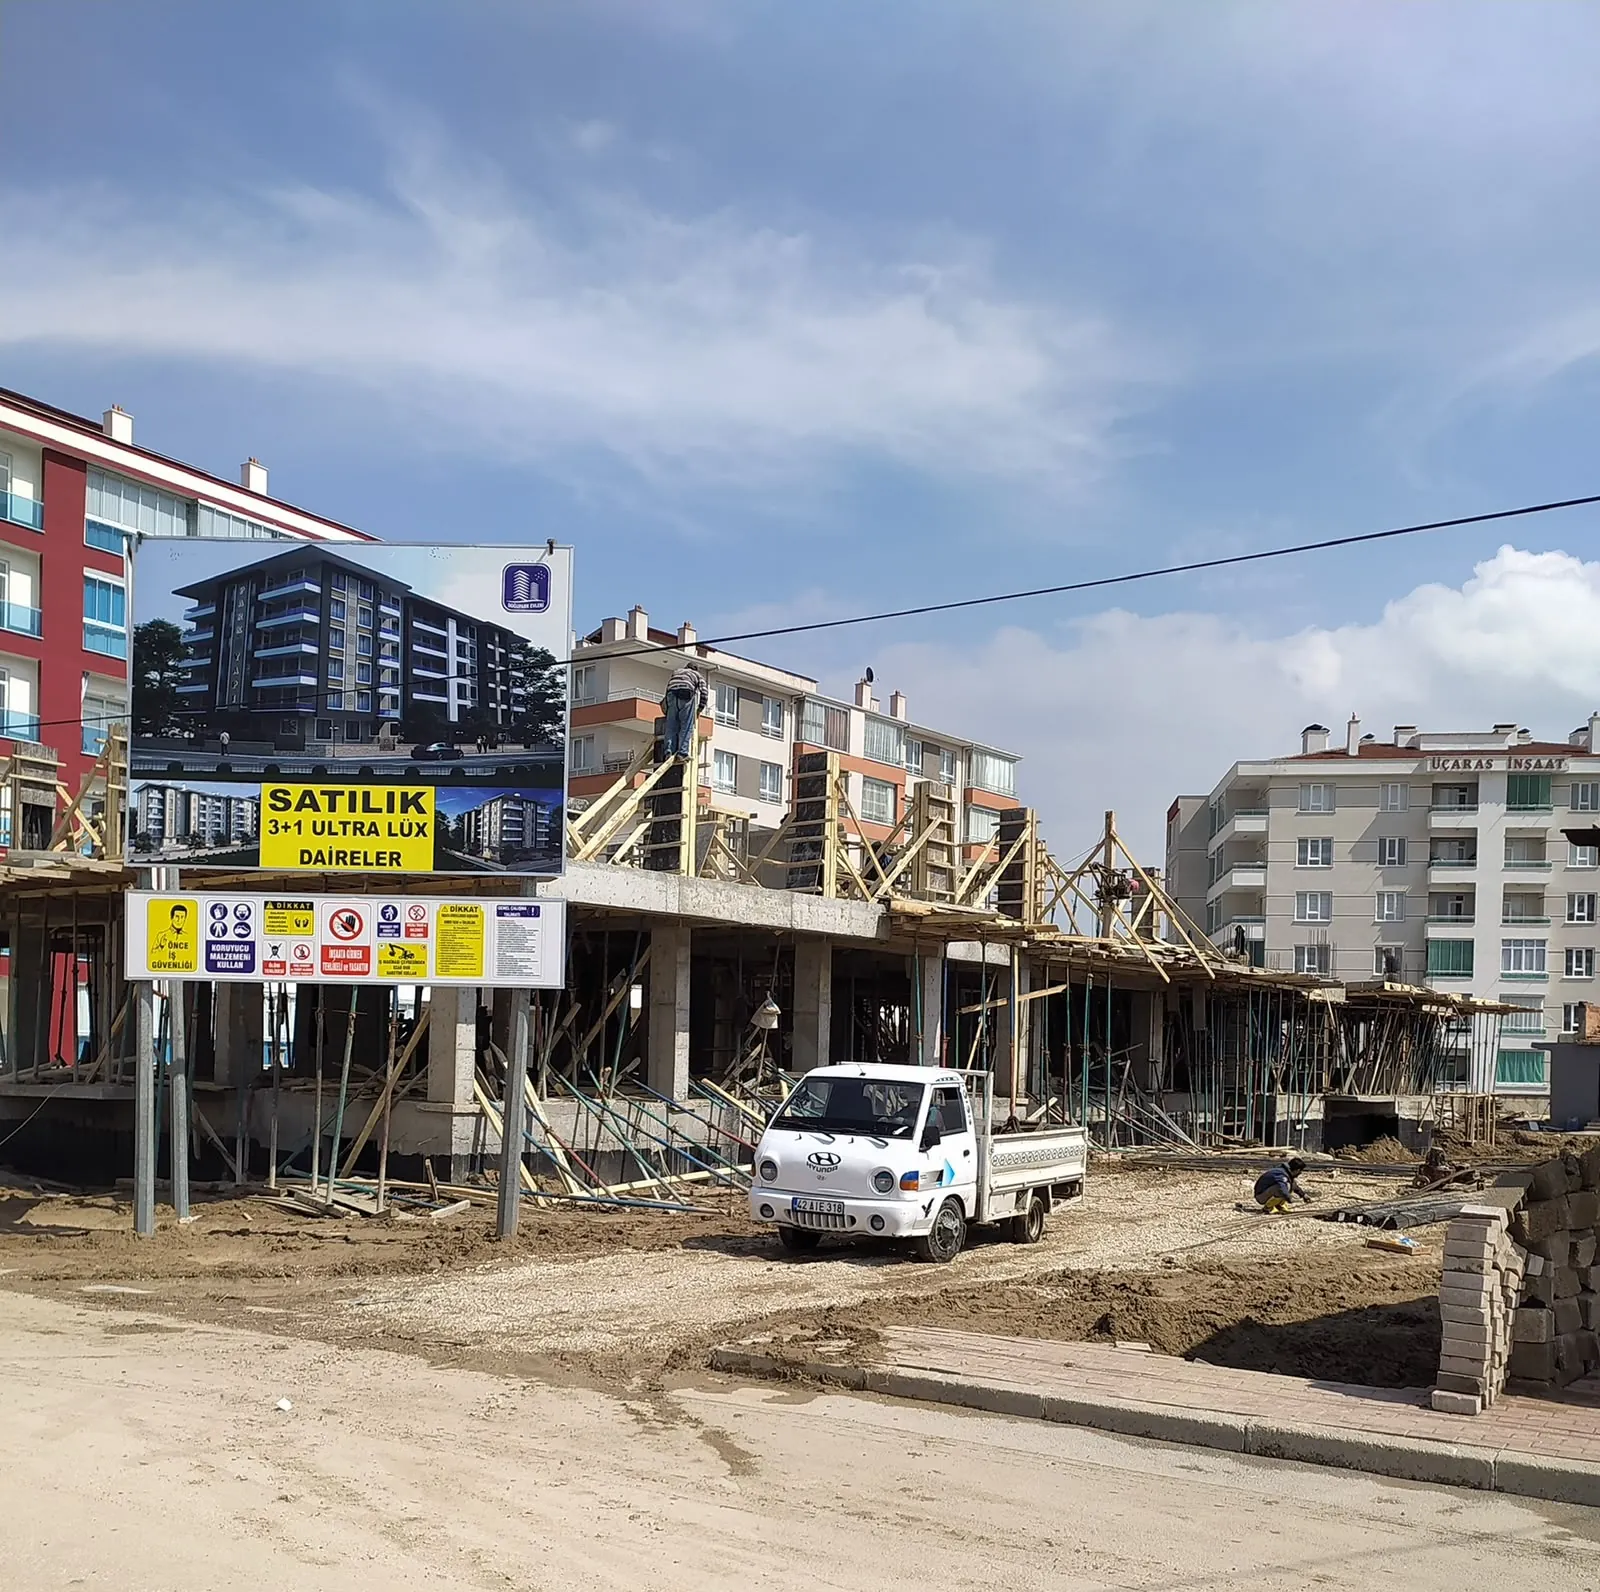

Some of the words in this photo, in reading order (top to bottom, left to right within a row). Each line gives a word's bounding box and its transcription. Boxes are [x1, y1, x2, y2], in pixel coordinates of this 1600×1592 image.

[1507, 756, 1565, 771] İNŞAAT
[268, 788, 428, 815] SATILIK
[268, 819, 303, 835] 3+1
[312, 820, 380, 837] ULTRA
[387, 818, 428, 838] LÜX
[300, 846, 402, 867] DAİRELER
[276, 901, 311, 910] DİKKAT
[450, 904, 479, 913] DİKKAT
[167, 941, 189, 950] ÖNCE
[211, 943, 250, 953] KORUYUCU
[168, 949, 176, 961] İŞ
[152, 959, 193, 970] GÜVENLİĞİ
[216, 961, 244, 969] KULLAN
[797, 1199, 808, 1210] 42
[809, 1201, 825, 1211] AIE
[826, 1202, 842, 1213] 318
